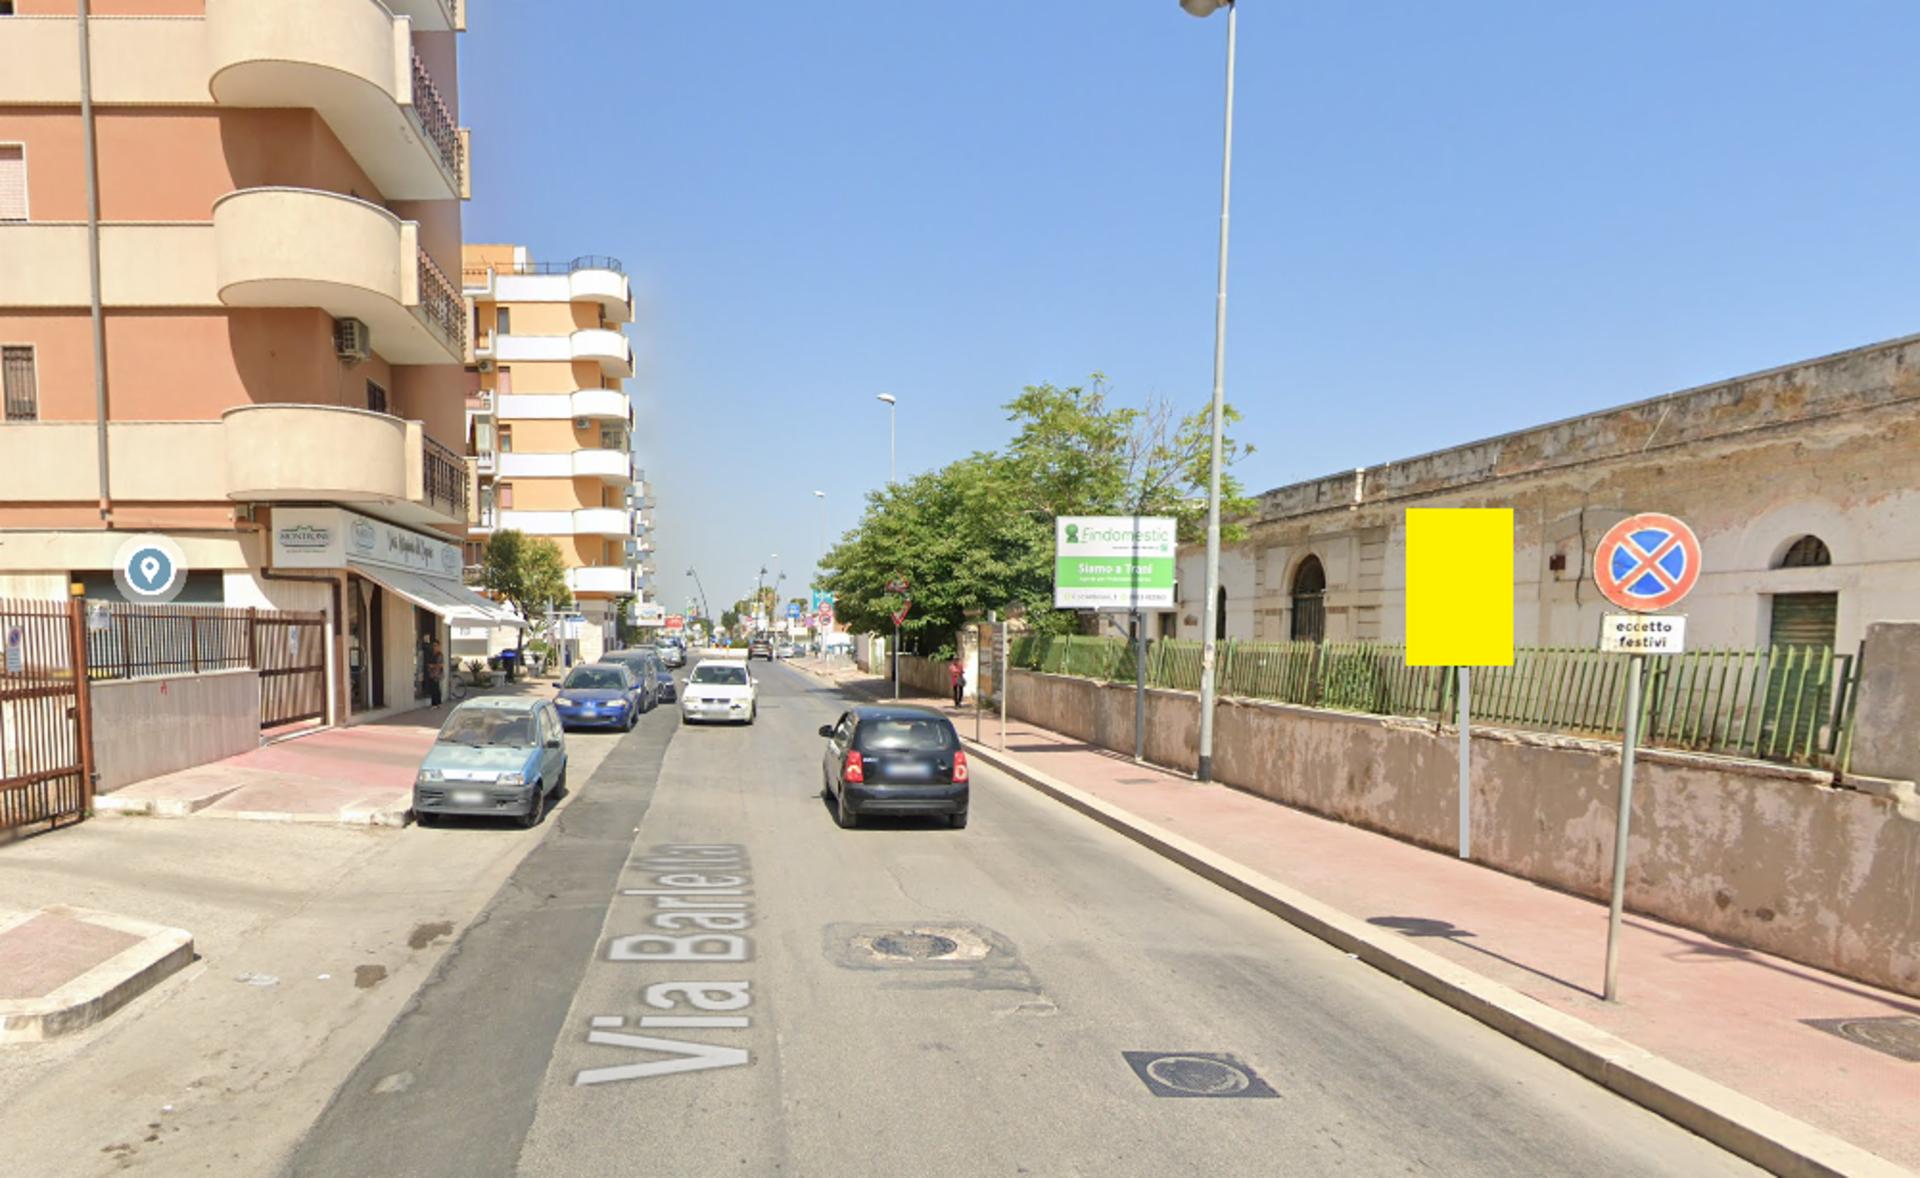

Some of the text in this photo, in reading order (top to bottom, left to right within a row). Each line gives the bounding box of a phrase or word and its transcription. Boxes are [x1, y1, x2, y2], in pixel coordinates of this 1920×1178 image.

[1081, 526, 1169, 543] Findomestic
[1078, 563, 1112, 574] Siamo
[1115, 565, 1121, 574] a
[1616, 621, 1672, 633] eccetto
[1619, 636, 1667, 648] festivi
